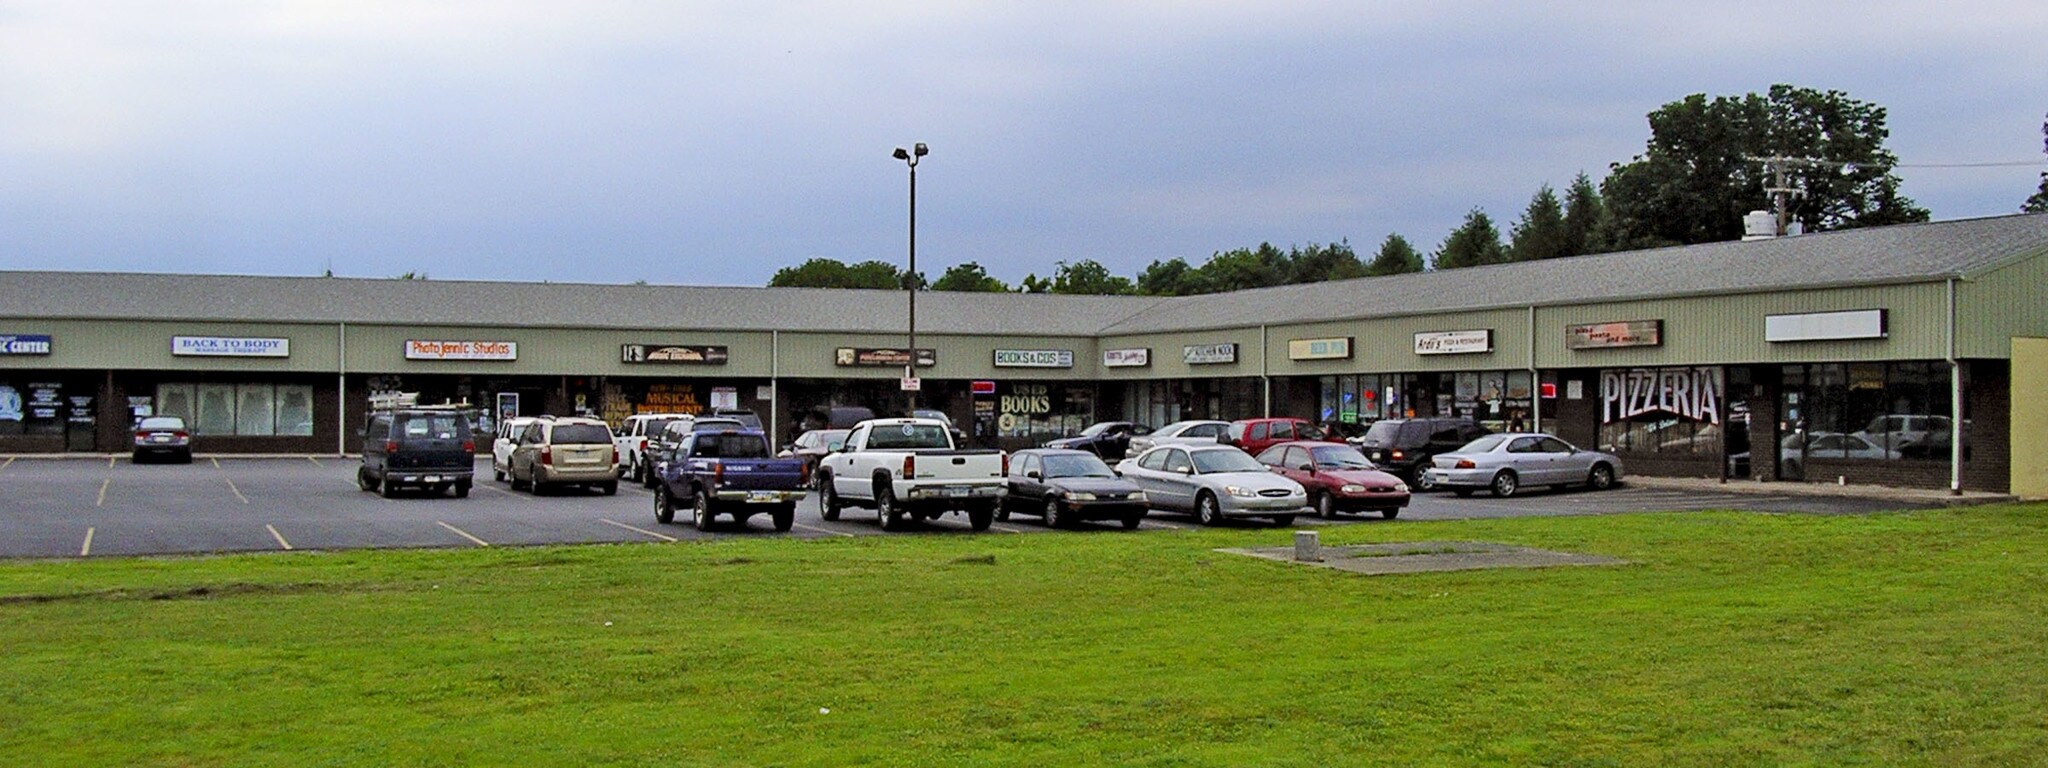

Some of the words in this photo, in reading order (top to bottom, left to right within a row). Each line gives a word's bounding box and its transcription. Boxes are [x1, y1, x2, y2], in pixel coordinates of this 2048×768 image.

[10, 341, 50, 353] CENTER
[244, 340, 279, 348] BODY
[474, 342, 509, 354] Studios
[646, 392, 696, 404] MUSICAL
[1603, 370, 1719, 425] PIZZERIA
[1001, 395, 1050, 413] BOOKS
